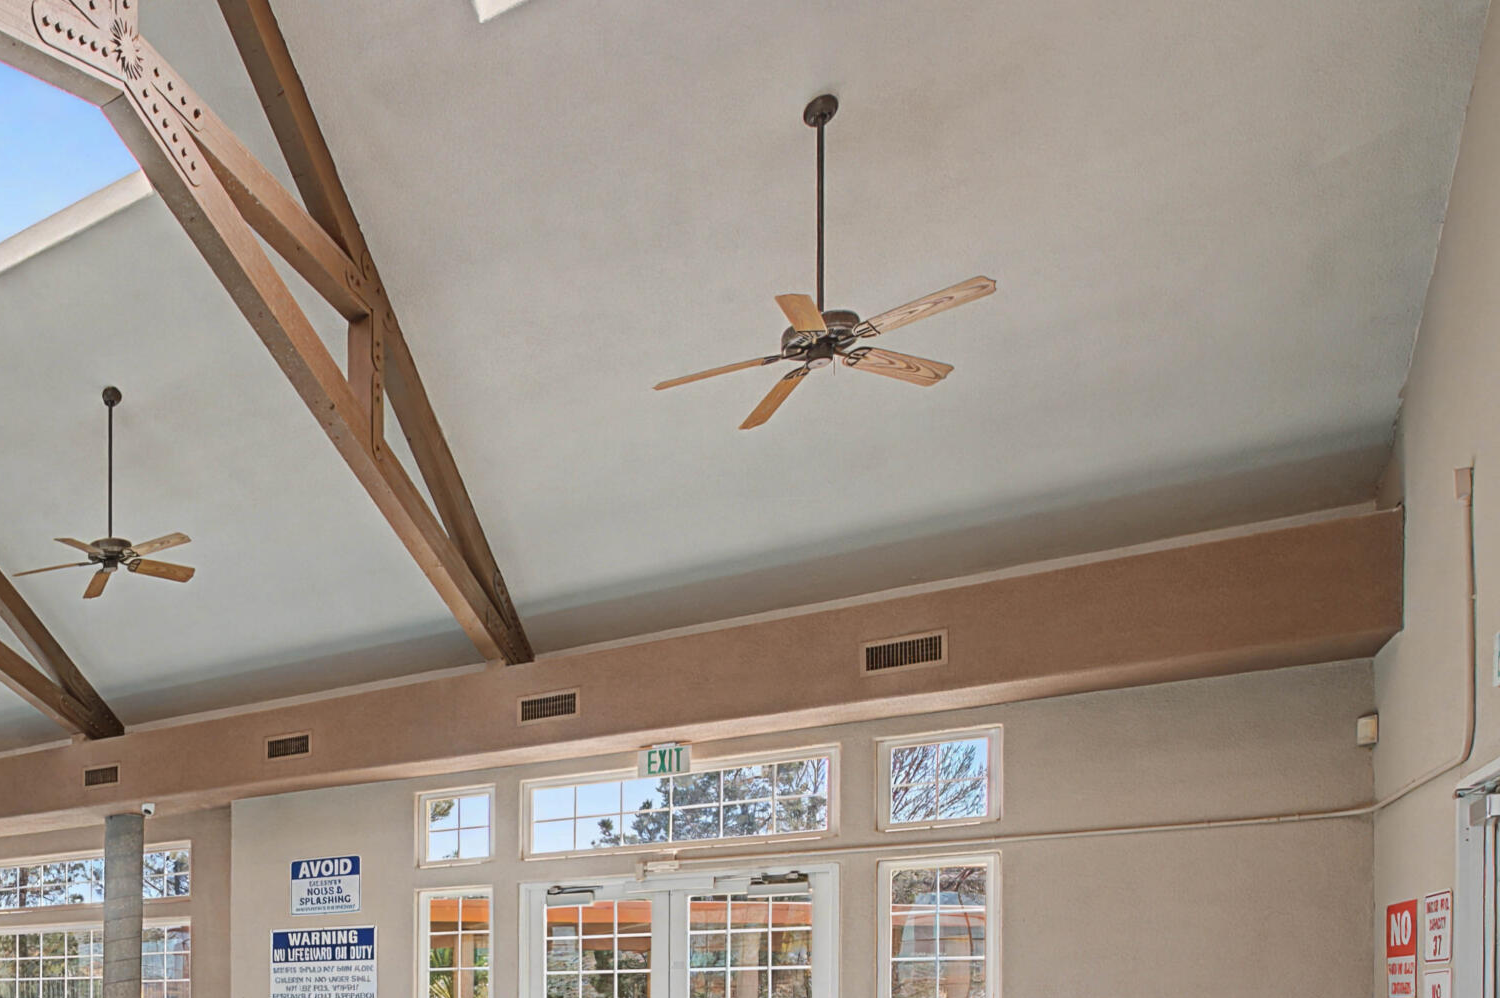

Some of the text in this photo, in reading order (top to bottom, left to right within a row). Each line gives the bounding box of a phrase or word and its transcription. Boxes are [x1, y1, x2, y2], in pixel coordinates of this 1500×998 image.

[648, 748, 683, 774] EXIT
[298, 858, 352, 878] AVOID
[299, 894, 351, 906] SPLASHING
[287, 930, 358, 946] WARNING
[1390, 910, 1412, 946] NO
[273, 945, 373, 962] NO LIFEGUARD ON DUTY
[1432, 935, 1442, 956] 37
